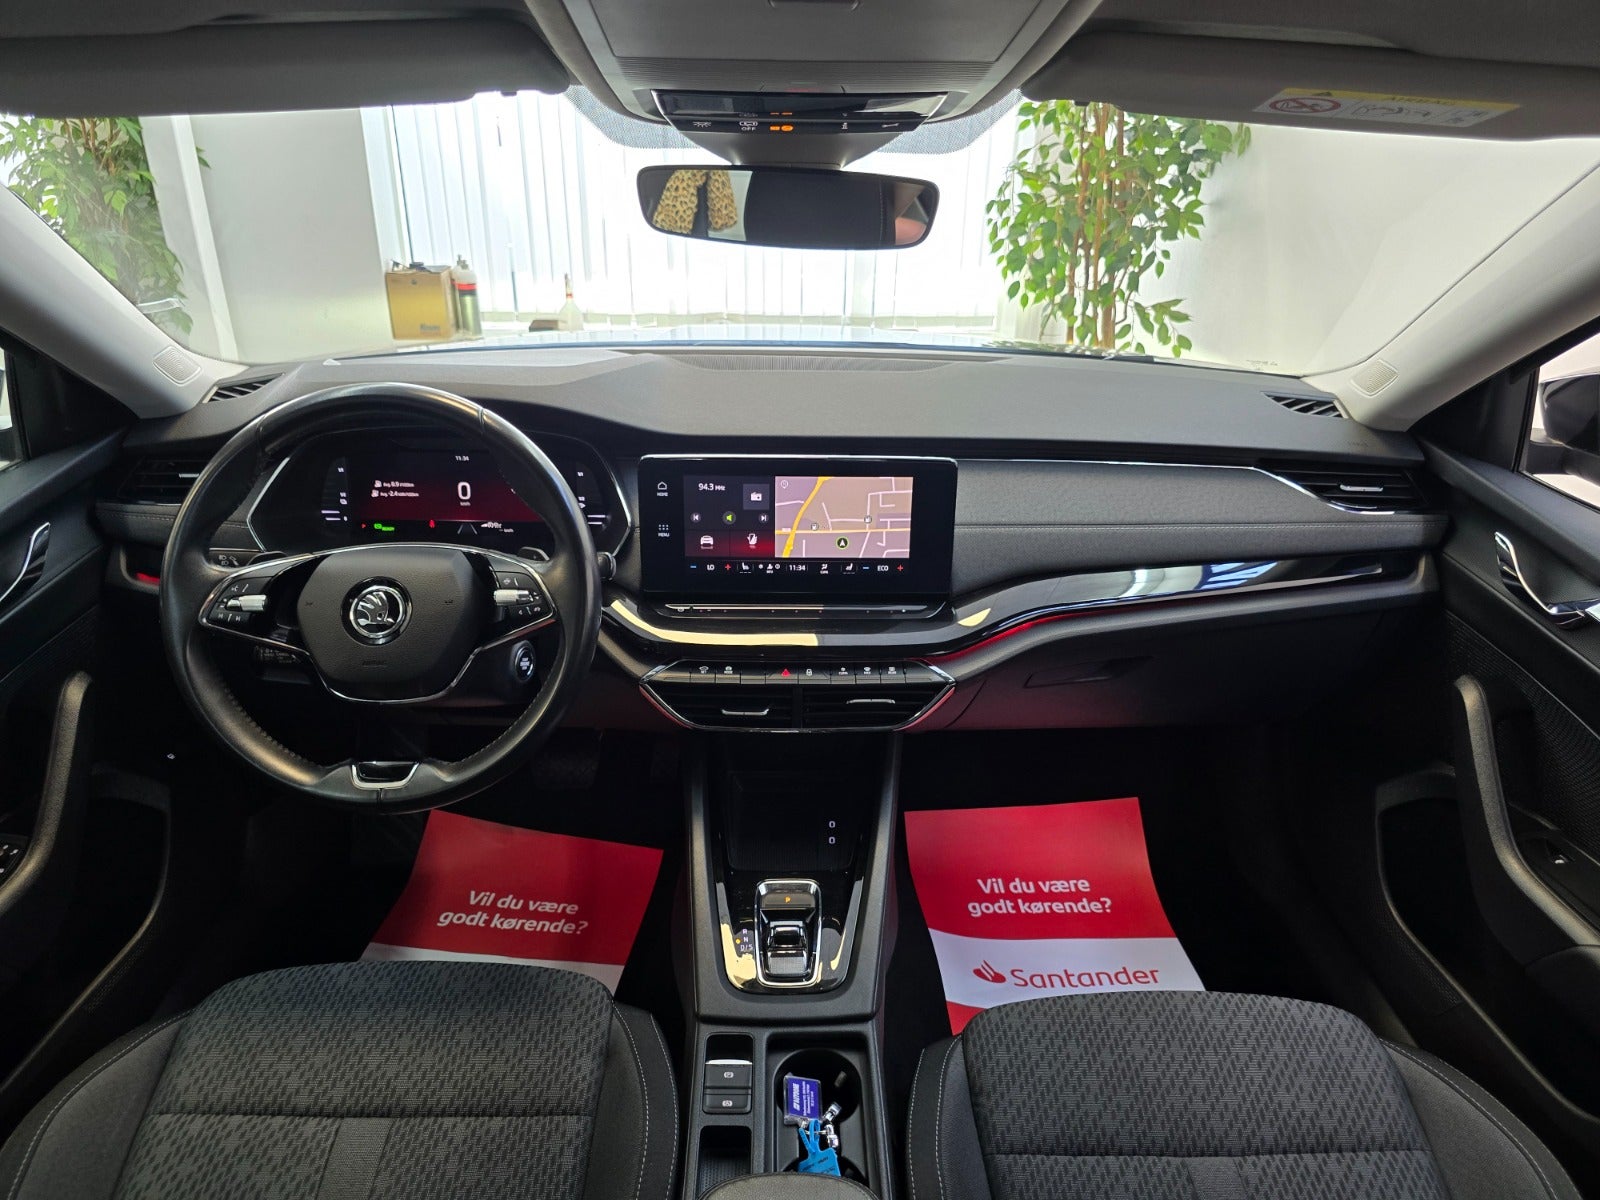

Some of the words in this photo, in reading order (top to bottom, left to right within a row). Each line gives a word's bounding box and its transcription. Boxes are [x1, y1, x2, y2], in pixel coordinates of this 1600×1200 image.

[457, 481, 471, 500] 0
[698, 483, 714, 491] 94.3
[977, 877, 1005, 894] Vil
[1009, 877, 1035, 894] du
[1038, 879, 1091, 893] være
[468, 890, 496, 907] Vil
[496, 894, 524, 910] du
[528, 900, 579, 914] være
[967, 898, 1016, 917] godt
[1017, 897, 1112, 914] kørende?
[436, 909, 490, 927] godt
[489, 912, 588, 935] kørende?
[1009, 965, 1160, 989] Santander
